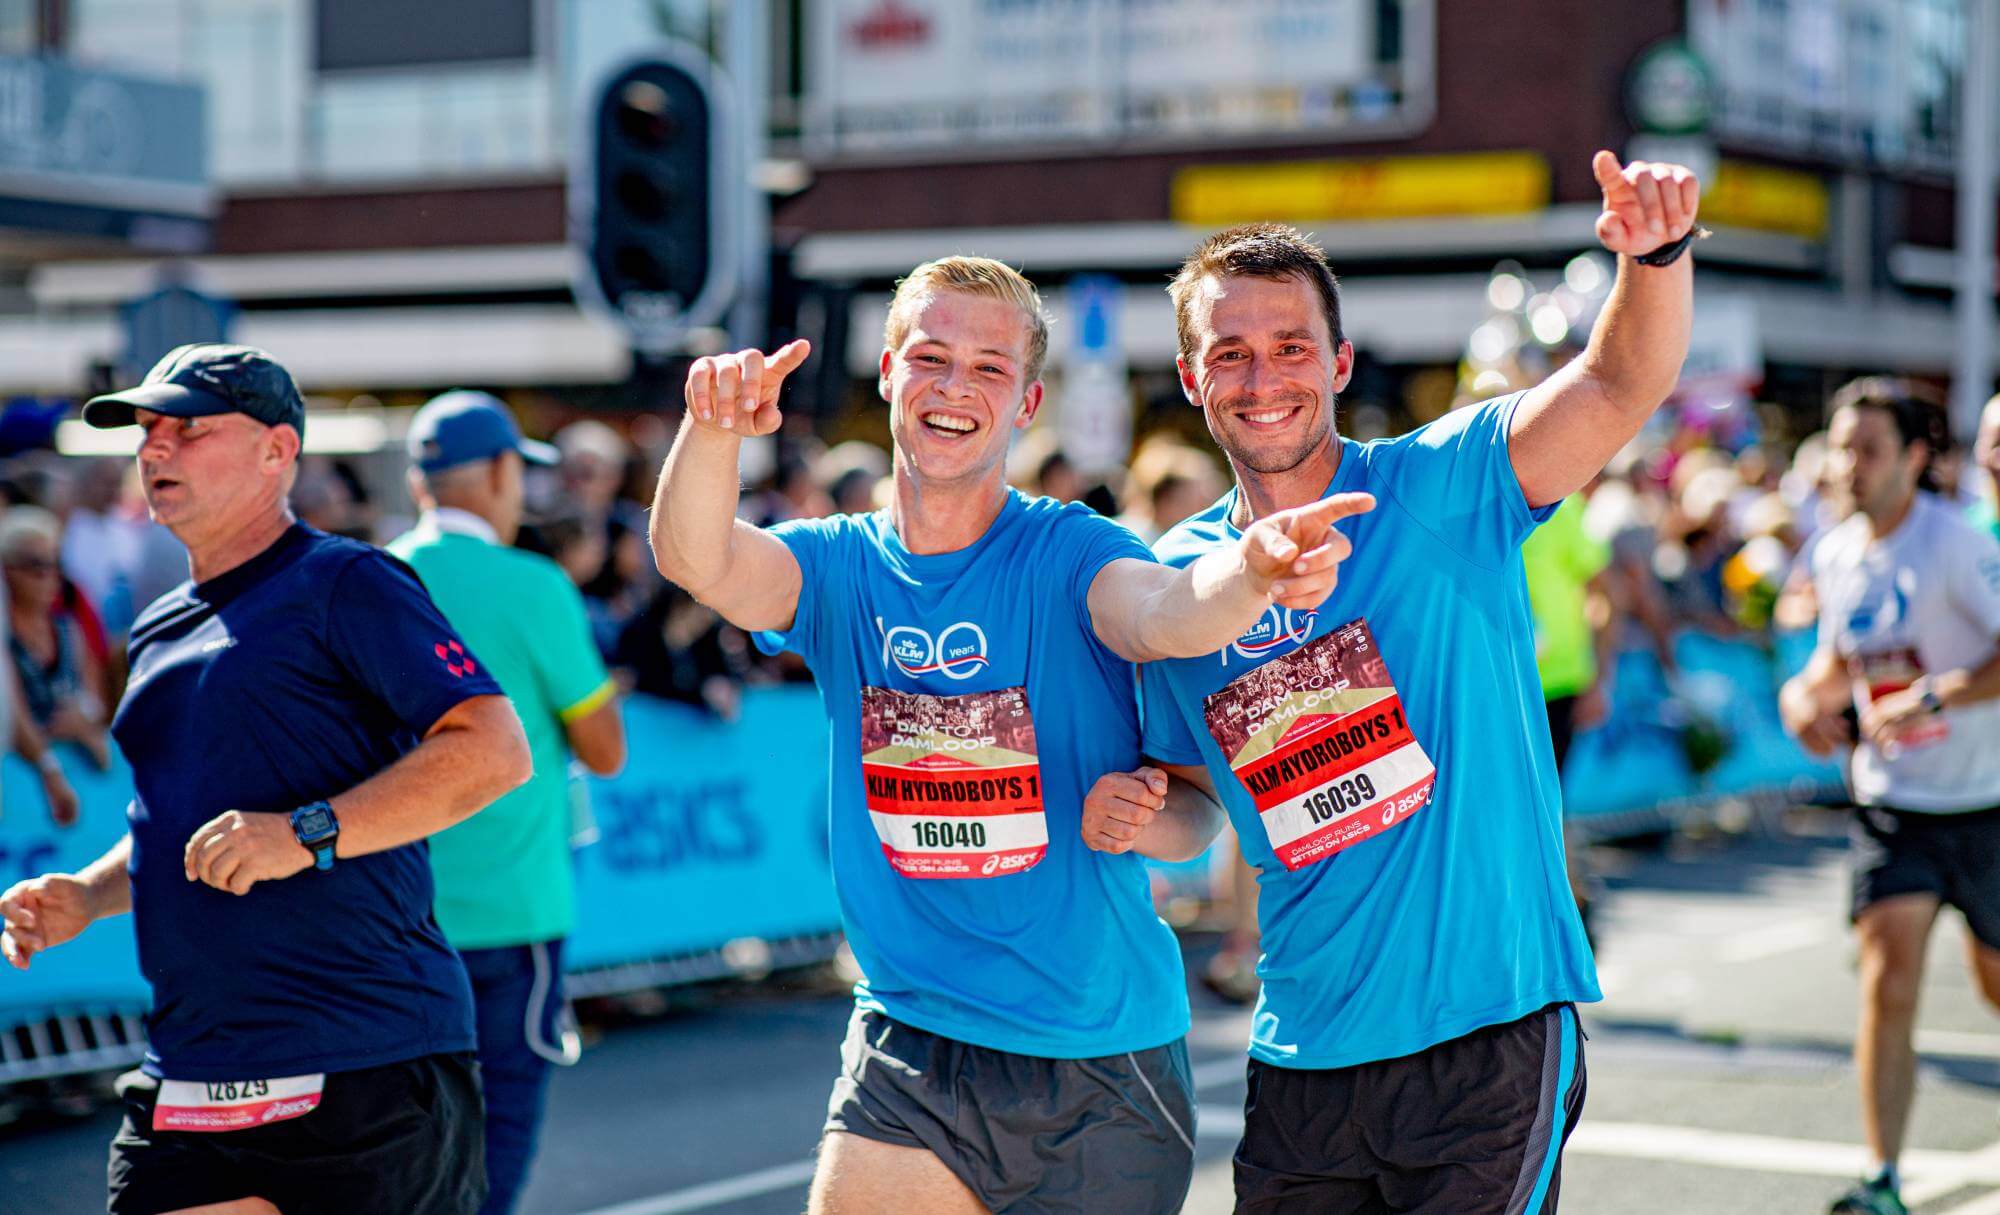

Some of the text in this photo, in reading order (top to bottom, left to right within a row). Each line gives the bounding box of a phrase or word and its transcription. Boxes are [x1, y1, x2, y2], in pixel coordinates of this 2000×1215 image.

[893, 645, 925, 659] KLM
[949, 645, 975, 658] years
[1246, 668, 1335, 720] DAM TOT
[1246, 679, 1350, 737] DAMLOOP
[890, 734, 997, 752] DAMLOOP
[897, 721, 986, 737] DAM TOT
[1245, 764, 1283, 797] KLM
[1279, 714, 1391, 784] HYDROBOYS
[1390, 707, 1405, 730] 1
[867, 774, 1038, 803] KLM HYDROBOYS 1
[1302, 773, 1377, 825] 16039
[912, 822, 986, 848] 16040
[1290, 823, 1371, 864] BETTER ON ASICS
[1291, 819, 1362, 855] DAMLOOP RUNS
[206, 1080, 269, 1102] 12829
